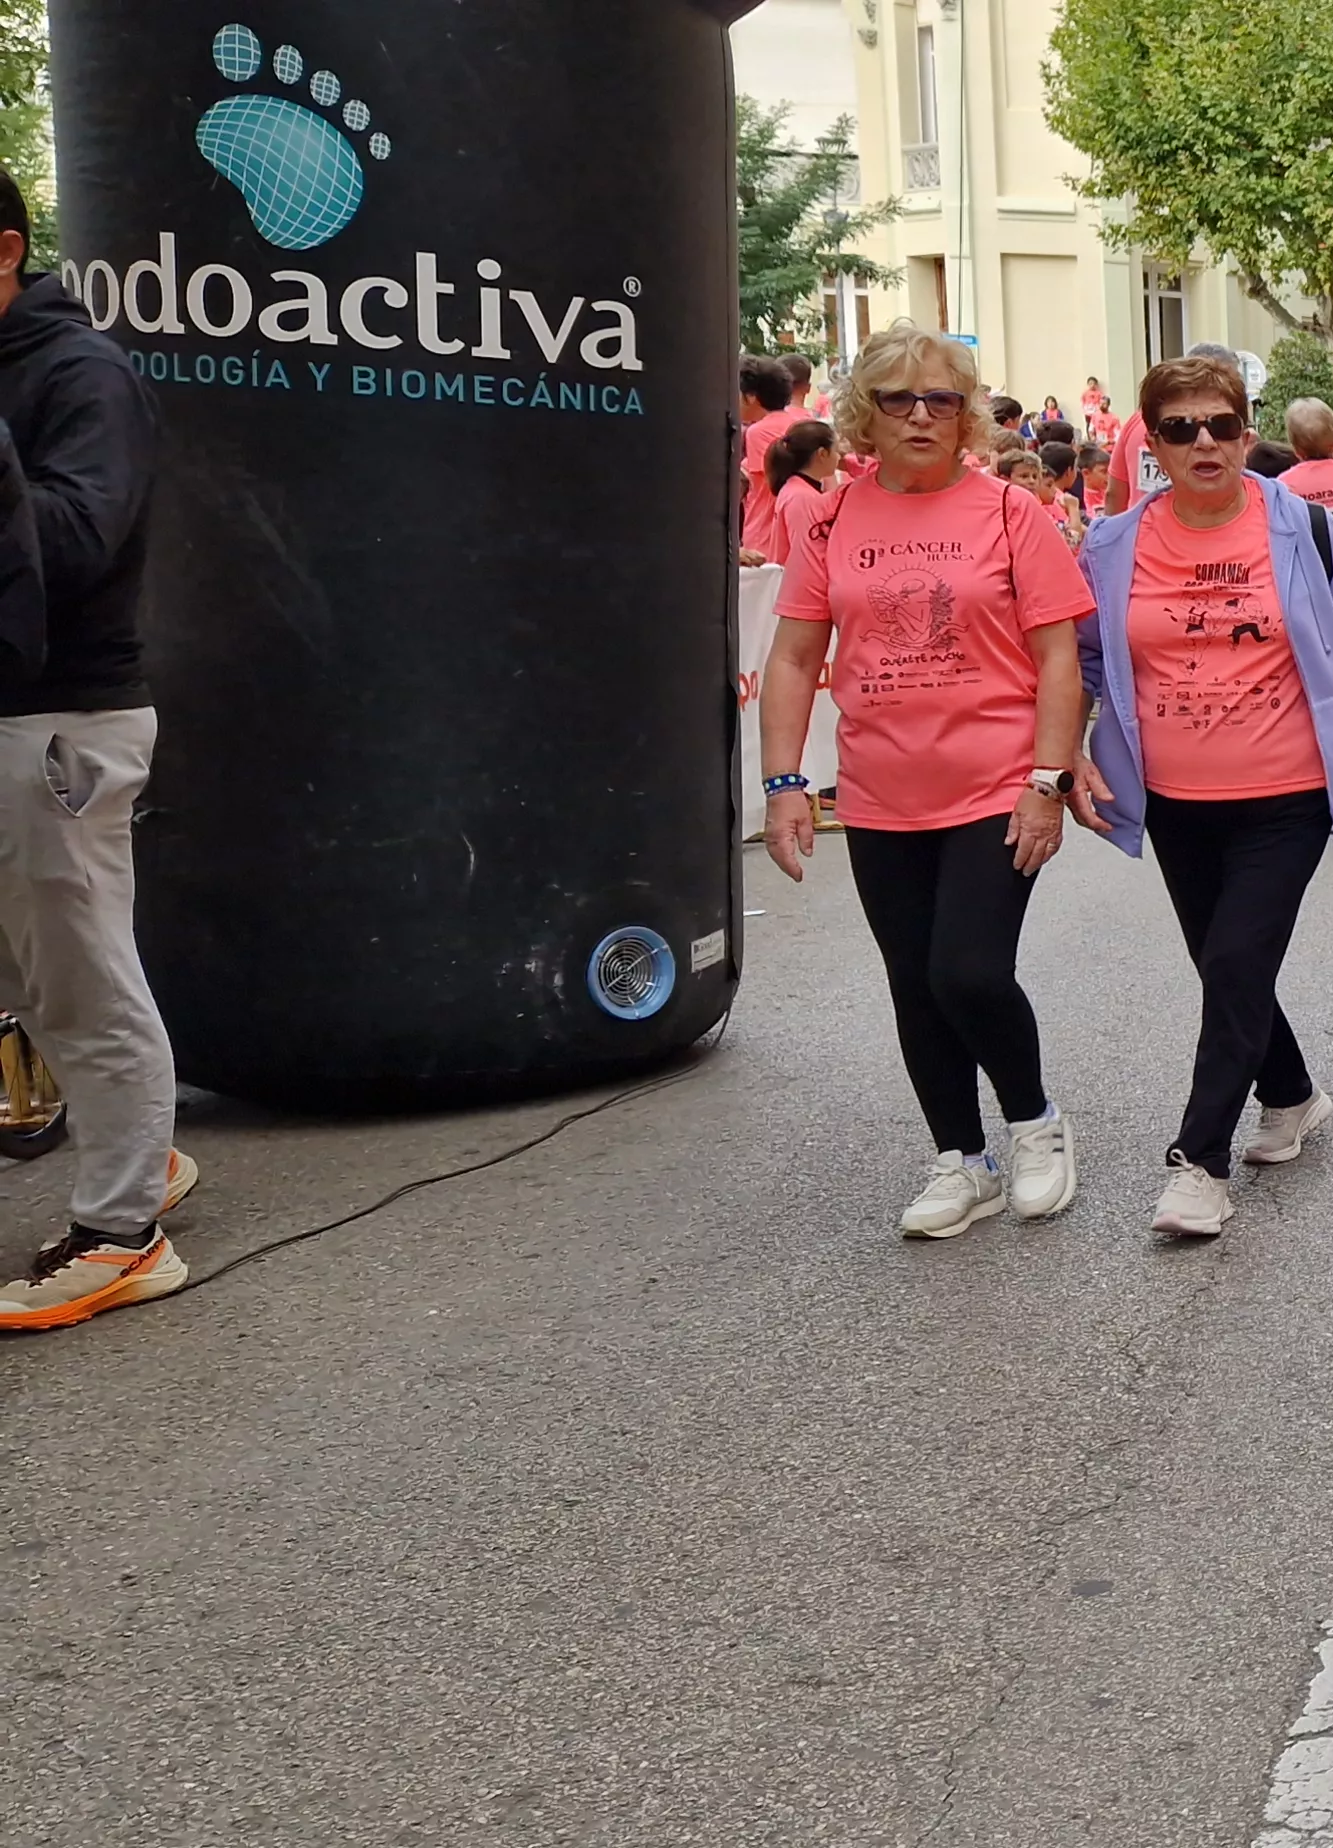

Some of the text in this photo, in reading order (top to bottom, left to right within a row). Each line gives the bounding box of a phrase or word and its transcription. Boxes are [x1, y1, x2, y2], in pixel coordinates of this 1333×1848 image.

[308, 361, 332, 392] Y
[352, 365, 644, 415] BIOMECÁNICA
[890, 540, 962, 555] CÁNCER
[926, 553, 975, 561] HUESCA
[930, 651, 967, 663] MUCHO
